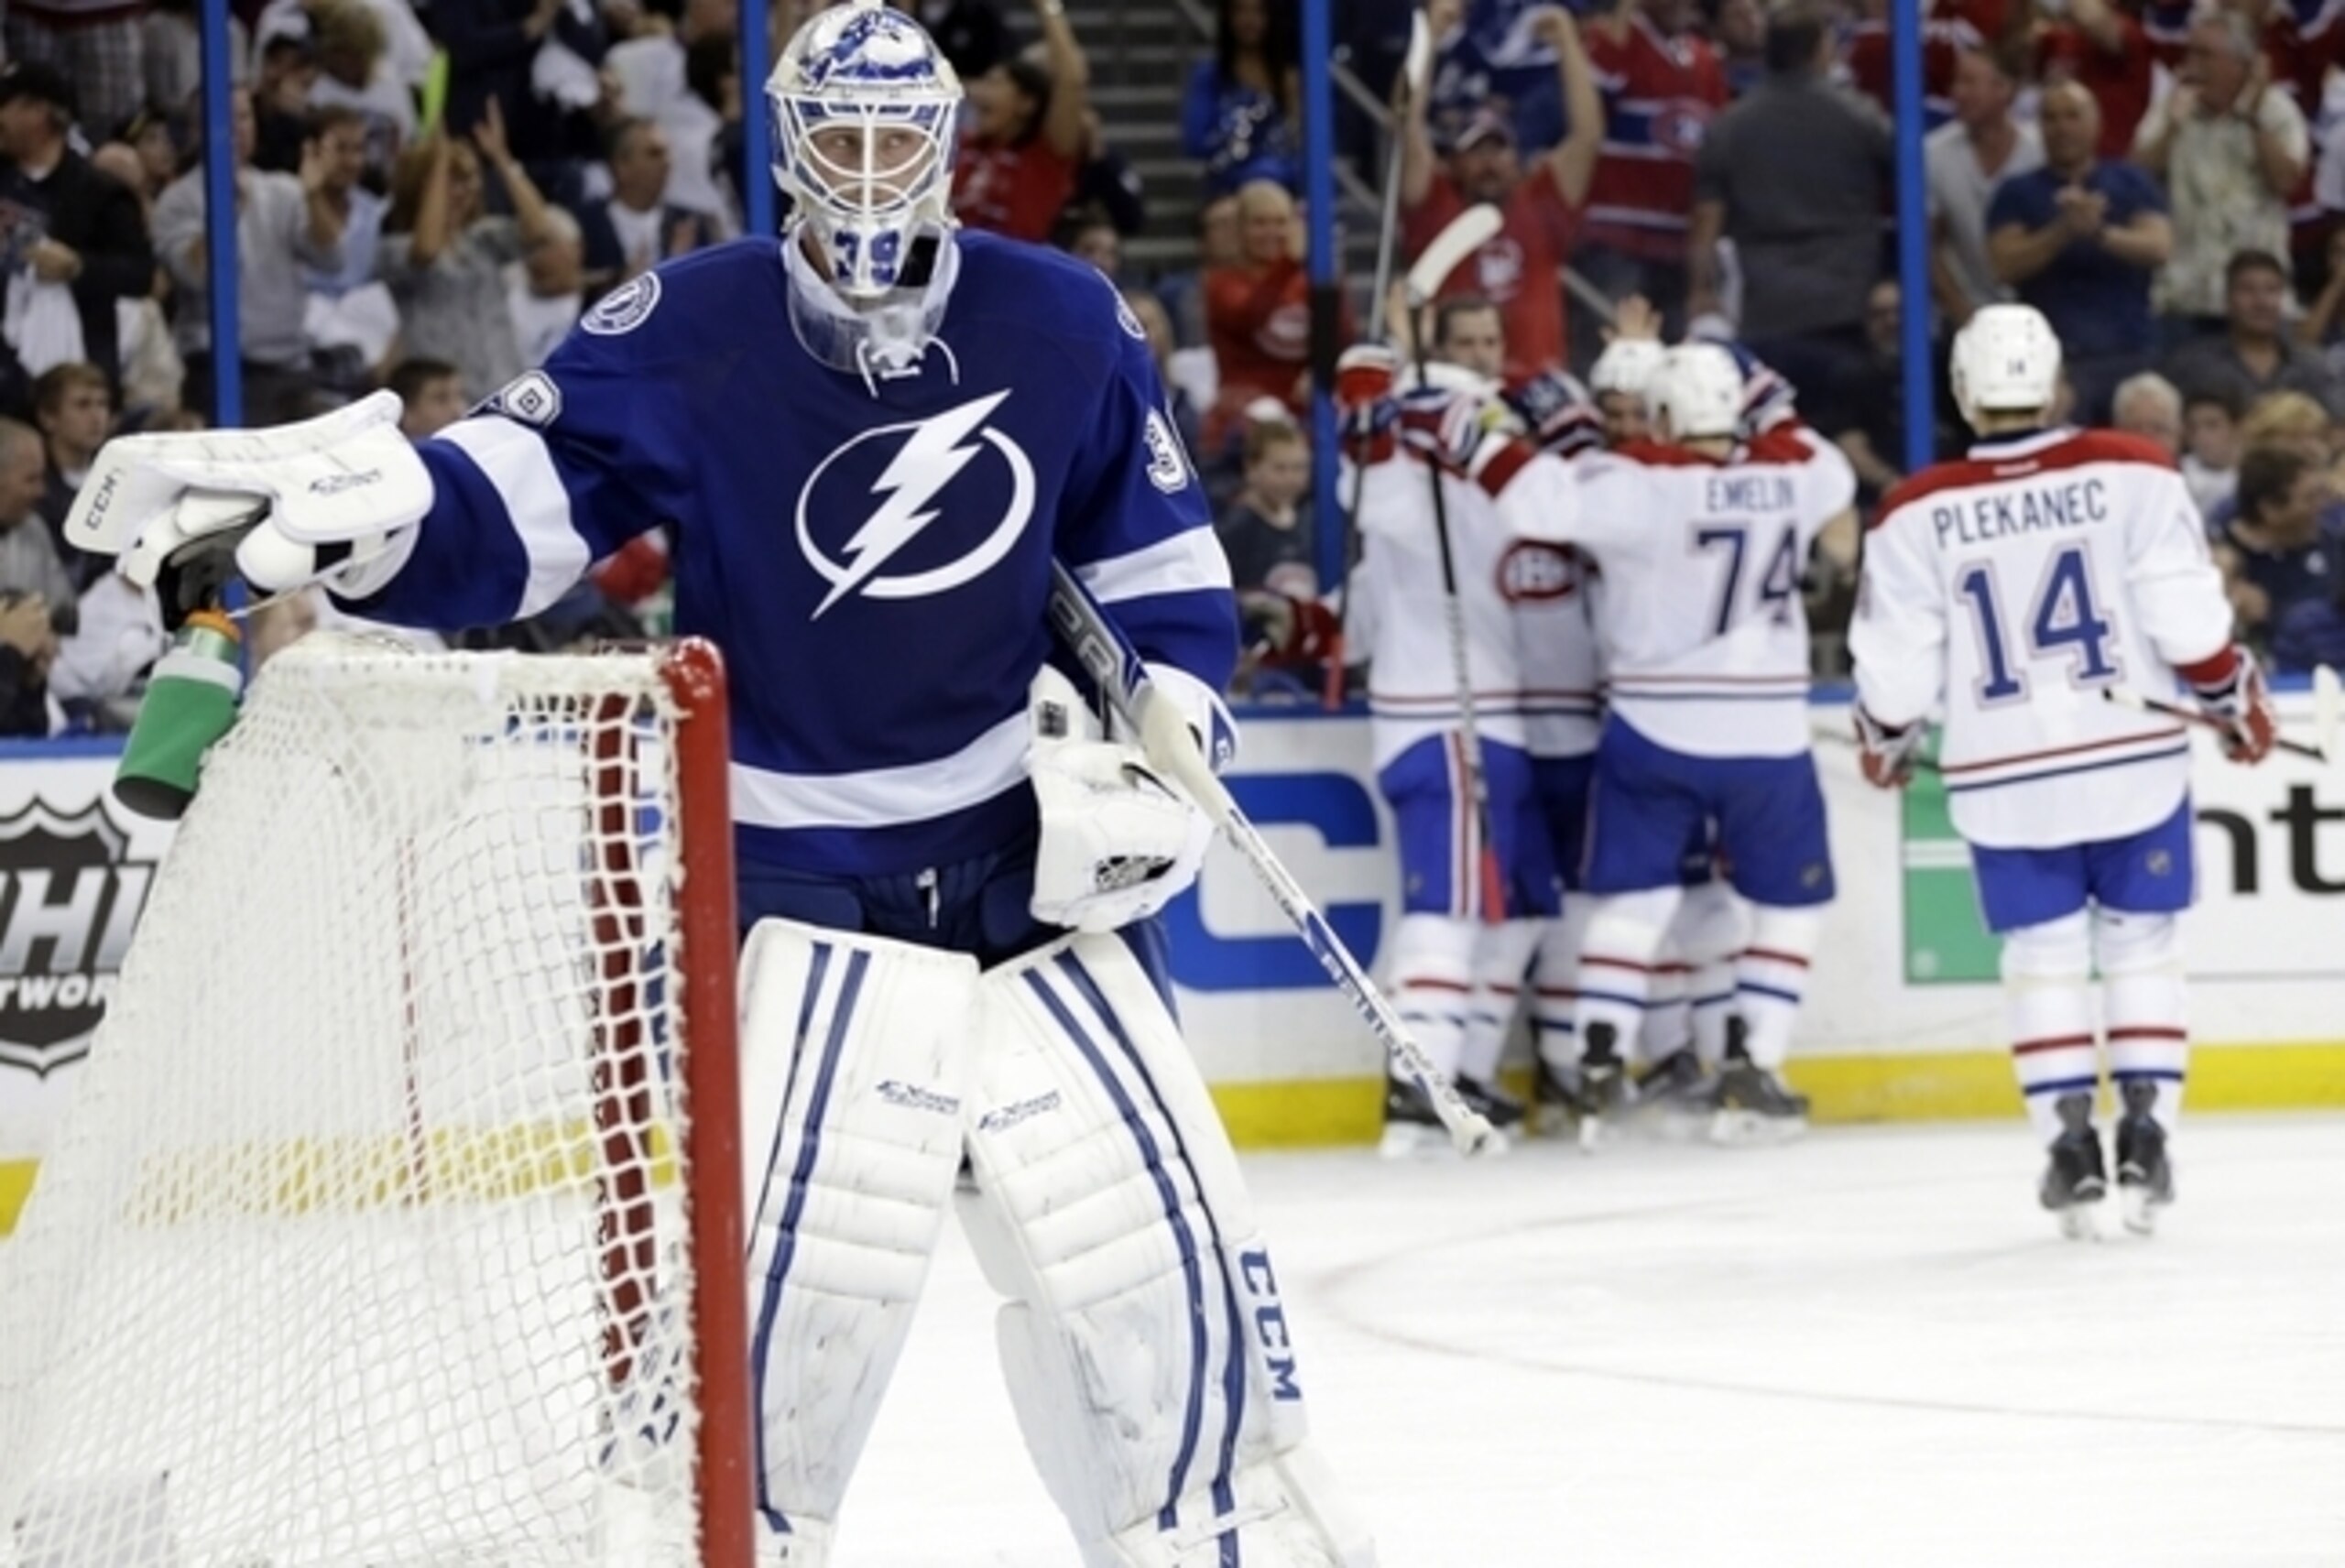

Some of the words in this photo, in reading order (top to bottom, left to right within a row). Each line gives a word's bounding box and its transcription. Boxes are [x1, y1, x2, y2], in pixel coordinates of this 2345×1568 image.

[833, 227, 901, 288] 39
[85, 474, 119, 532] CCM
[1706, 475, 1796, 515] EMELIN
[1932, 477, 2107, 550] PLEKANEC
[1687, 520, 1803, 647] 74
[1952, 537, 2128, 713] 14
[1239, 1247, 1303, 1403] CCM
